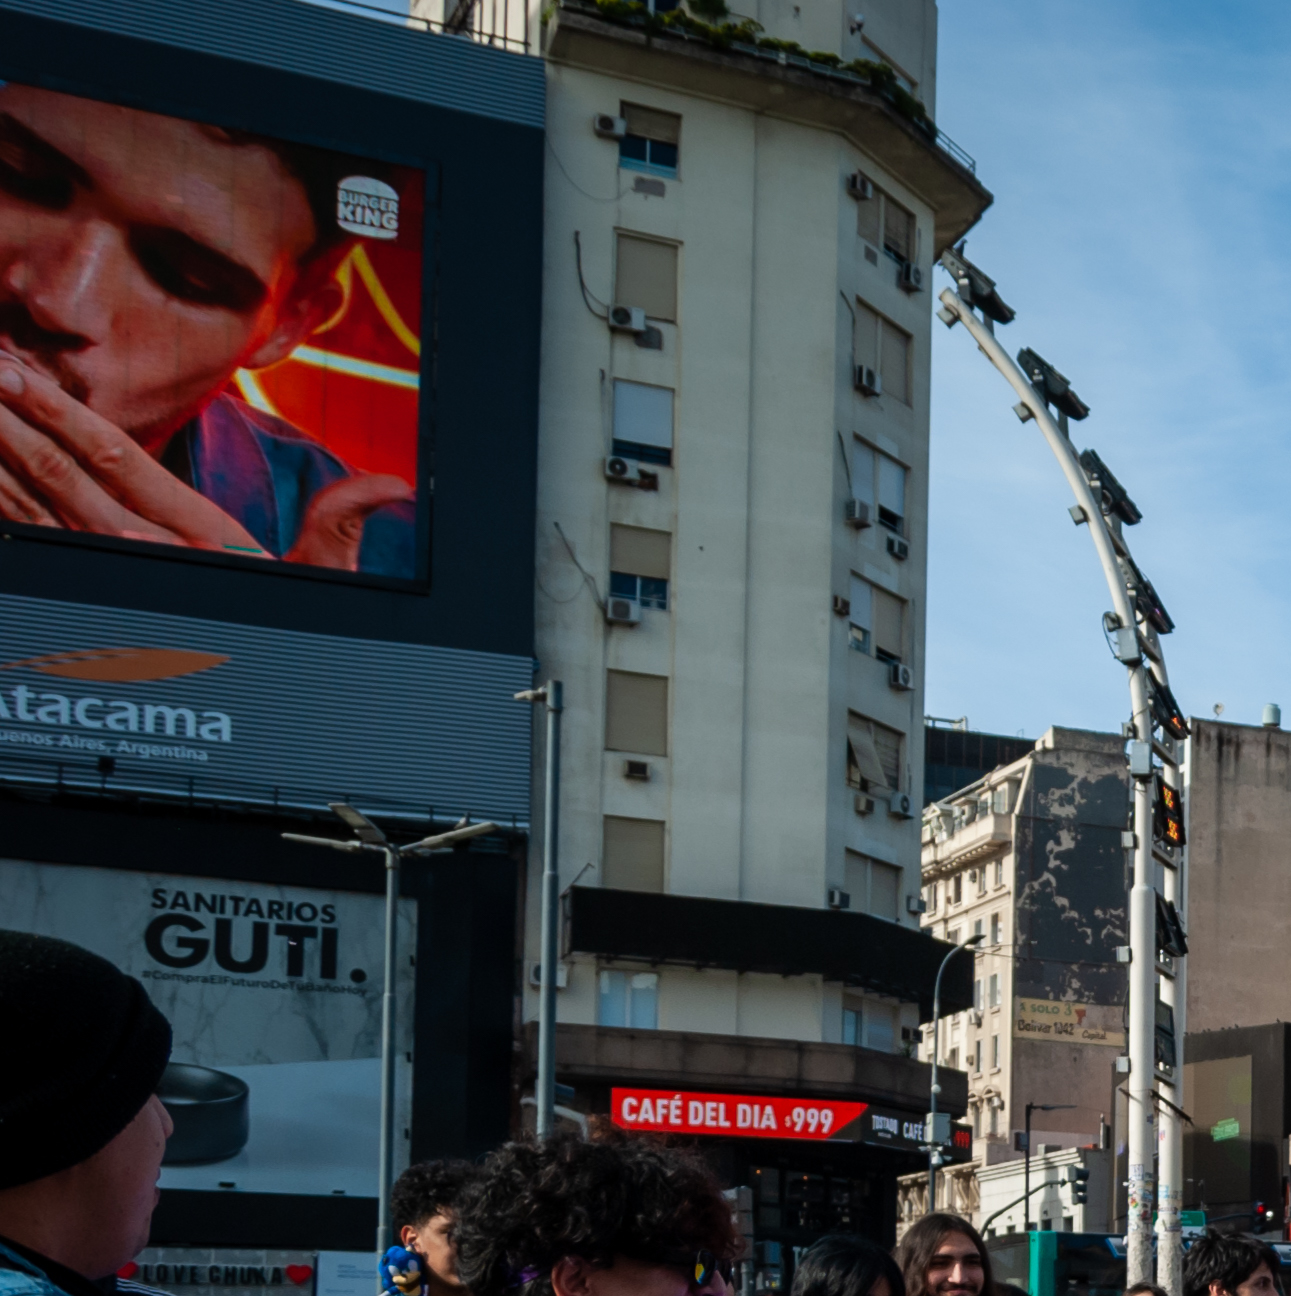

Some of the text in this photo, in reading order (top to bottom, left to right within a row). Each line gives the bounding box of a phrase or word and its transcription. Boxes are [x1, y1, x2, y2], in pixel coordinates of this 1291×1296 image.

[338, 190, 398, 213] BURGER
[338, 203, 398, 230] KING
[0, 731, 208, 761] uenos Aires, Argentina
[151, 888, 337, 924] SANITARIOS
[145, 912, 367, 985] GUTI.
[1030, 1003, 1060, 1015] SOLO
[621, 1094, 683, 1125] CAFÉ
[688, 1100, 731, 1128] DEL
[736, 1103, 777, 1130] DIA
[903, 1120, 922, 1141] CAFÉ
[143, 1264, 205, 1285] LOVE
